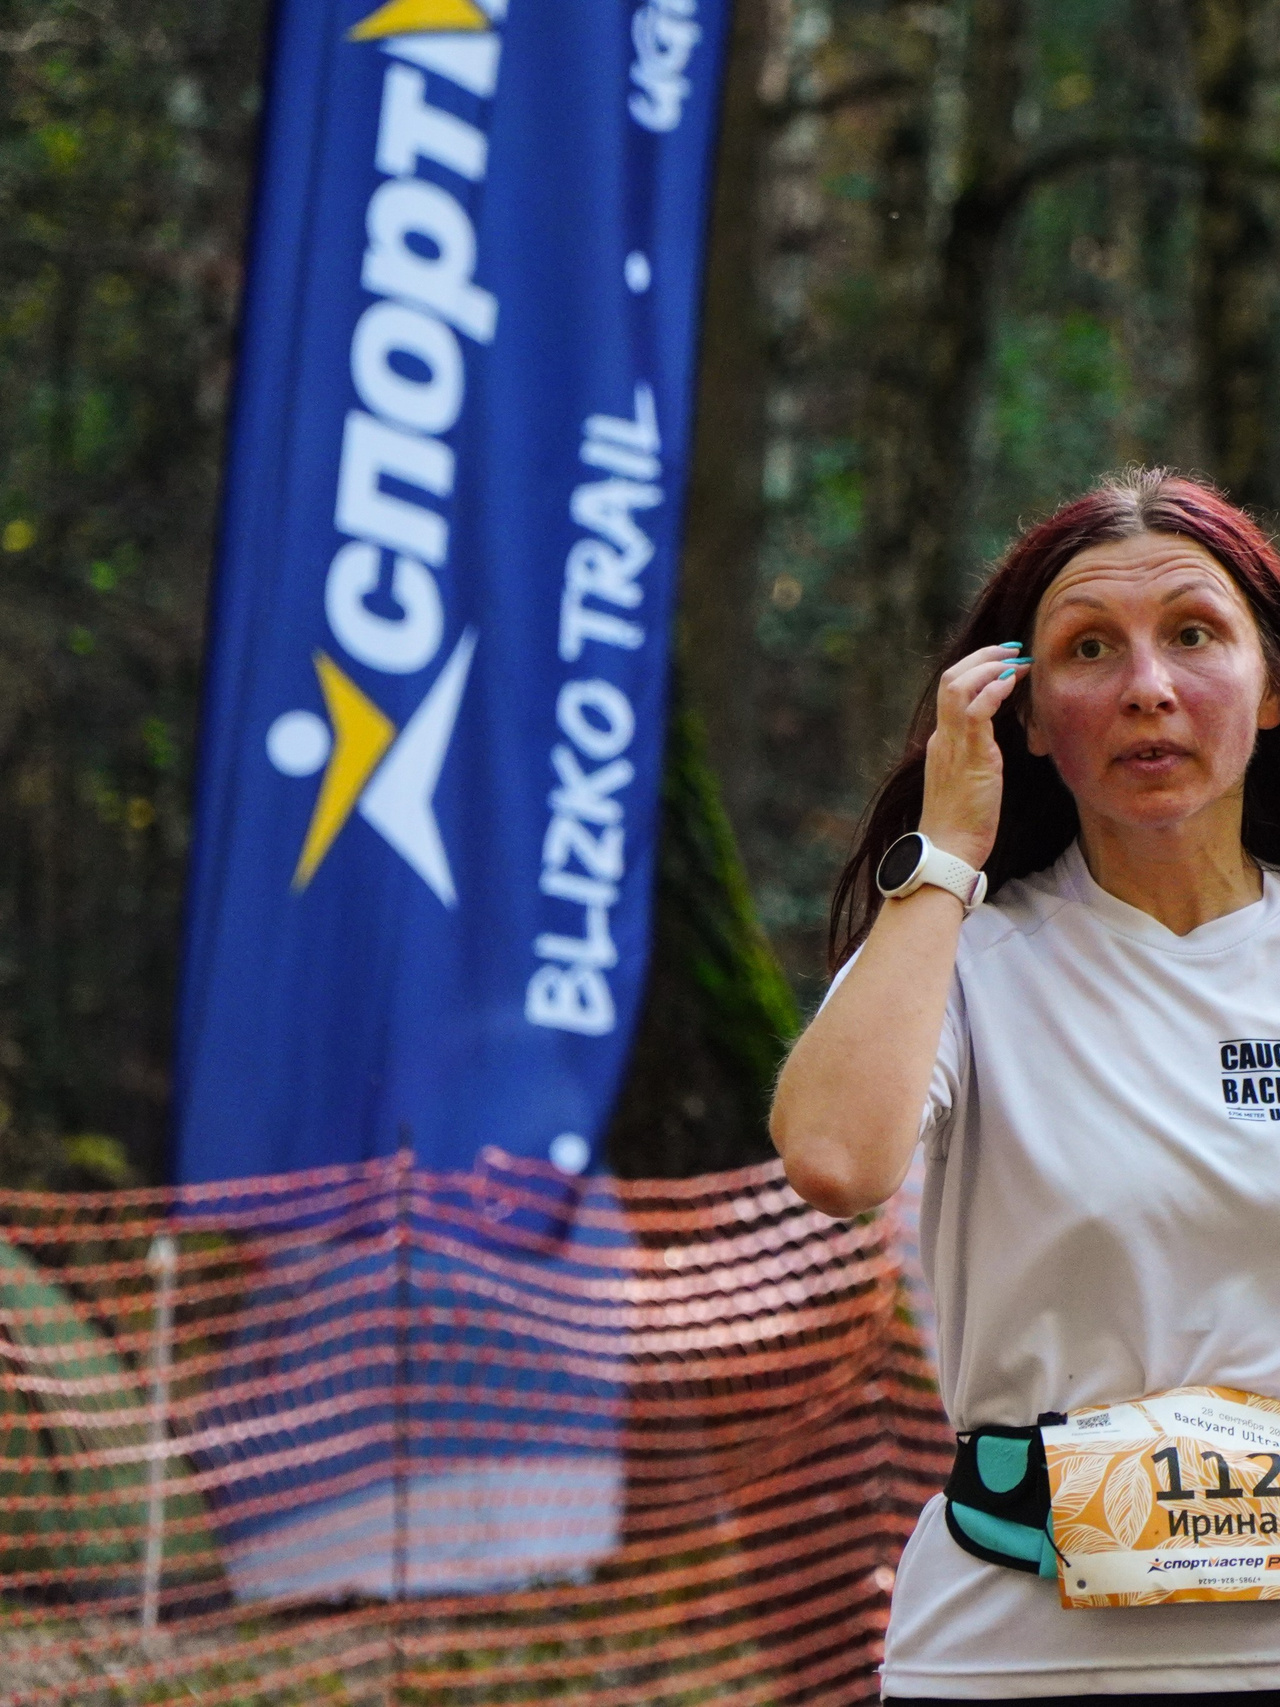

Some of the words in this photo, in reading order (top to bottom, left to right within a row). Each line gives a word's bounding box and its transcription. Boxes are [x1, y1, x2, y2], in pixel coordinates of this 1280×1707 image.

[559, 381, 663, 662] TRAIL
[525, 679, 634, 1035] BLIZKO
[1173, 1411, 1235, 1436] Backyard
[1241, 1430, 1280, 1448] Ultra
[1201, 1406, 1214, 1417] 28
[1218, 1411, 1265, 1432] сентября
[1168, 1509, 1278, 1544] Ирина
